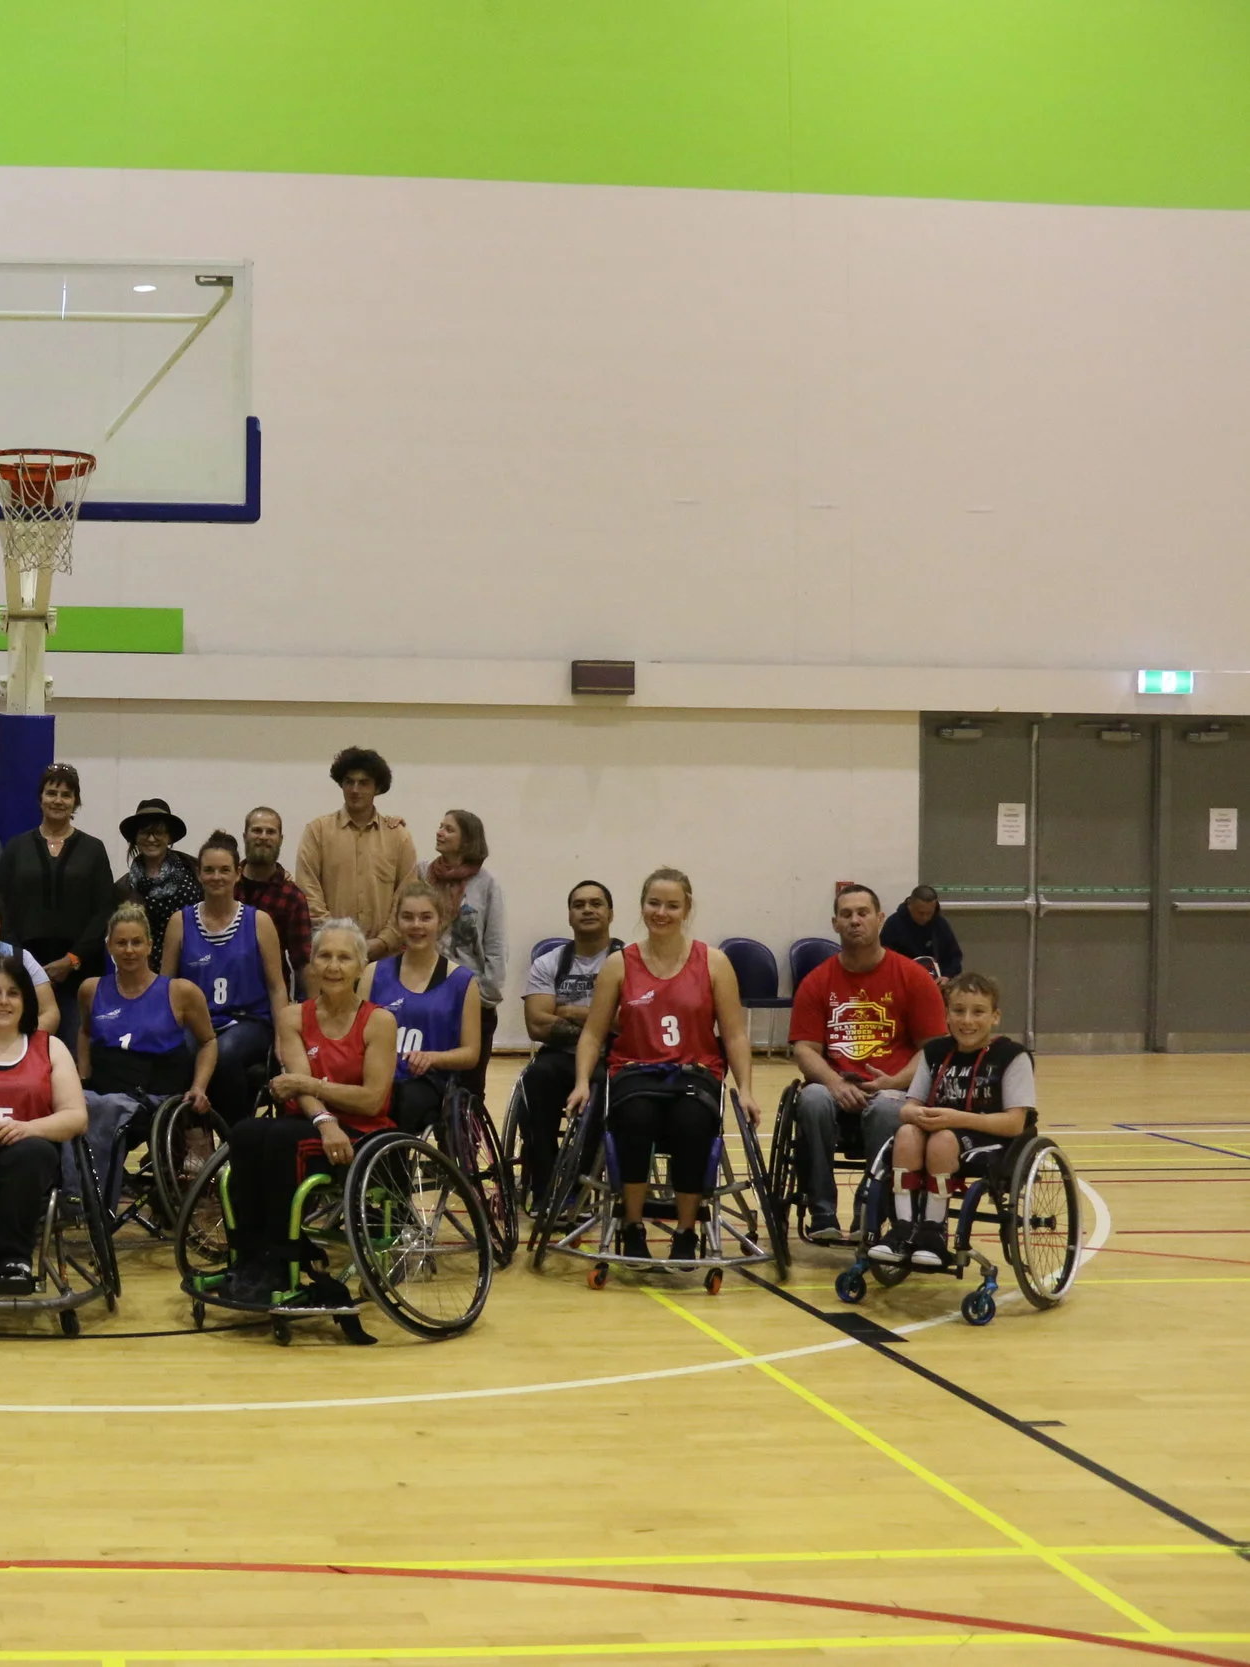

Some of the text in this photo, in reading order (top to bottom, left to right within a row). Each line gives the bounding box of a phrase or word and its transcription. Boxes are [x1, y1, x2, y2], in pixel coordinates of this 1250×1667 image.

[213, 977, 228, 1005] 8
[119, 1033, 132, 1050] 1
[396, 1026, 424, 1054] 10
[661, 1015, 680, 1047] 3
[833, 1024, 857, 1032] SLAM
